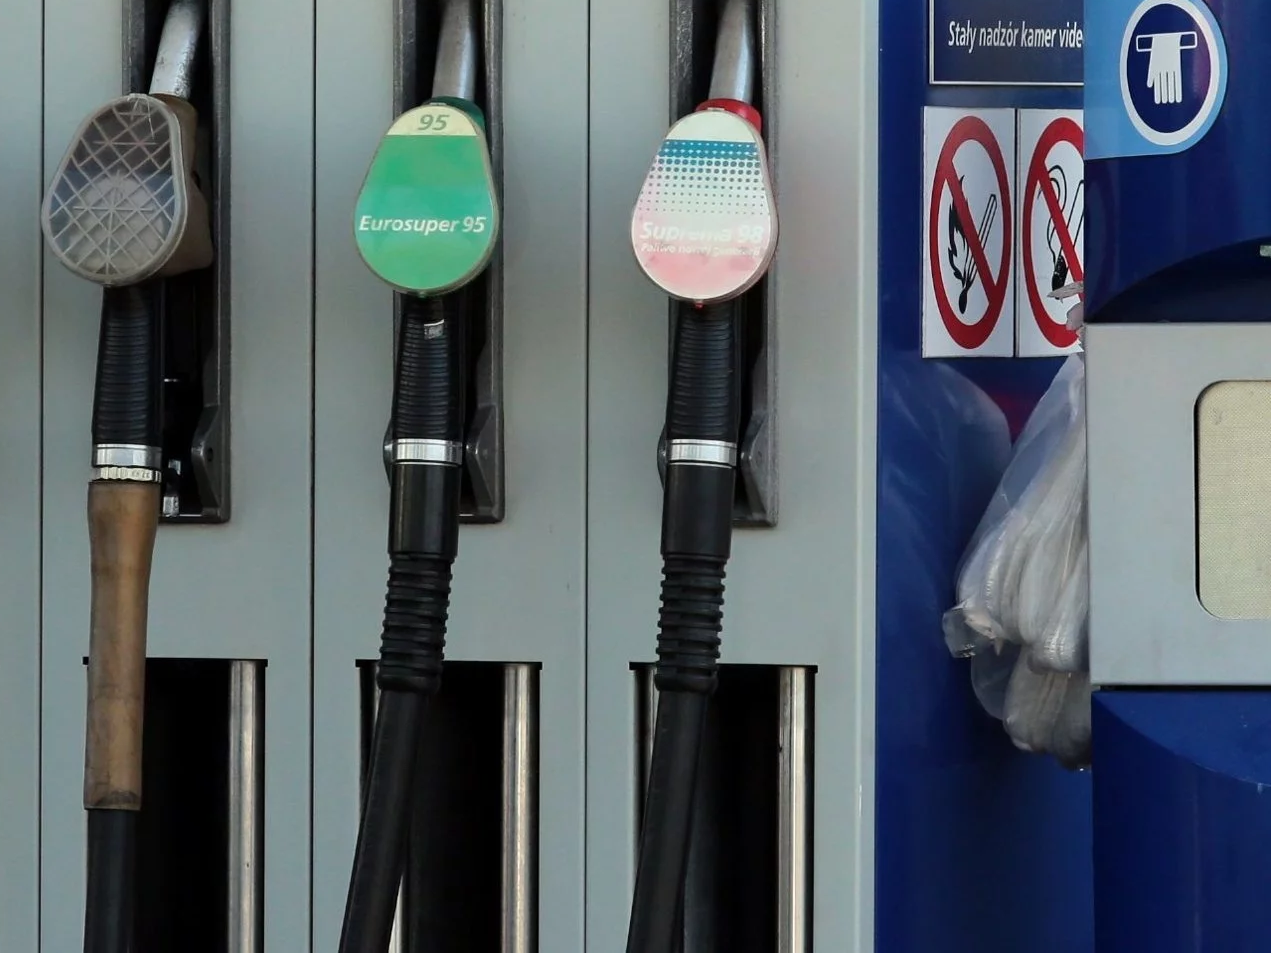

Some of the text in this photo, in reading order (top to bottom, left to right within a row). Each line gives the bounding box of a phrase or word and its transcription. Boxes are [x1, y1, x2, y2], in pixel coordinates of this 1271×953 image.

[948, 20, 976, 53] Stały
[979, 21, 1019, 47] nadzór
[1020, 21, 1056, 48] kamer
[418, 114, 450, 131] 95
[358, 215, 487, 236] Eurosuper 95
